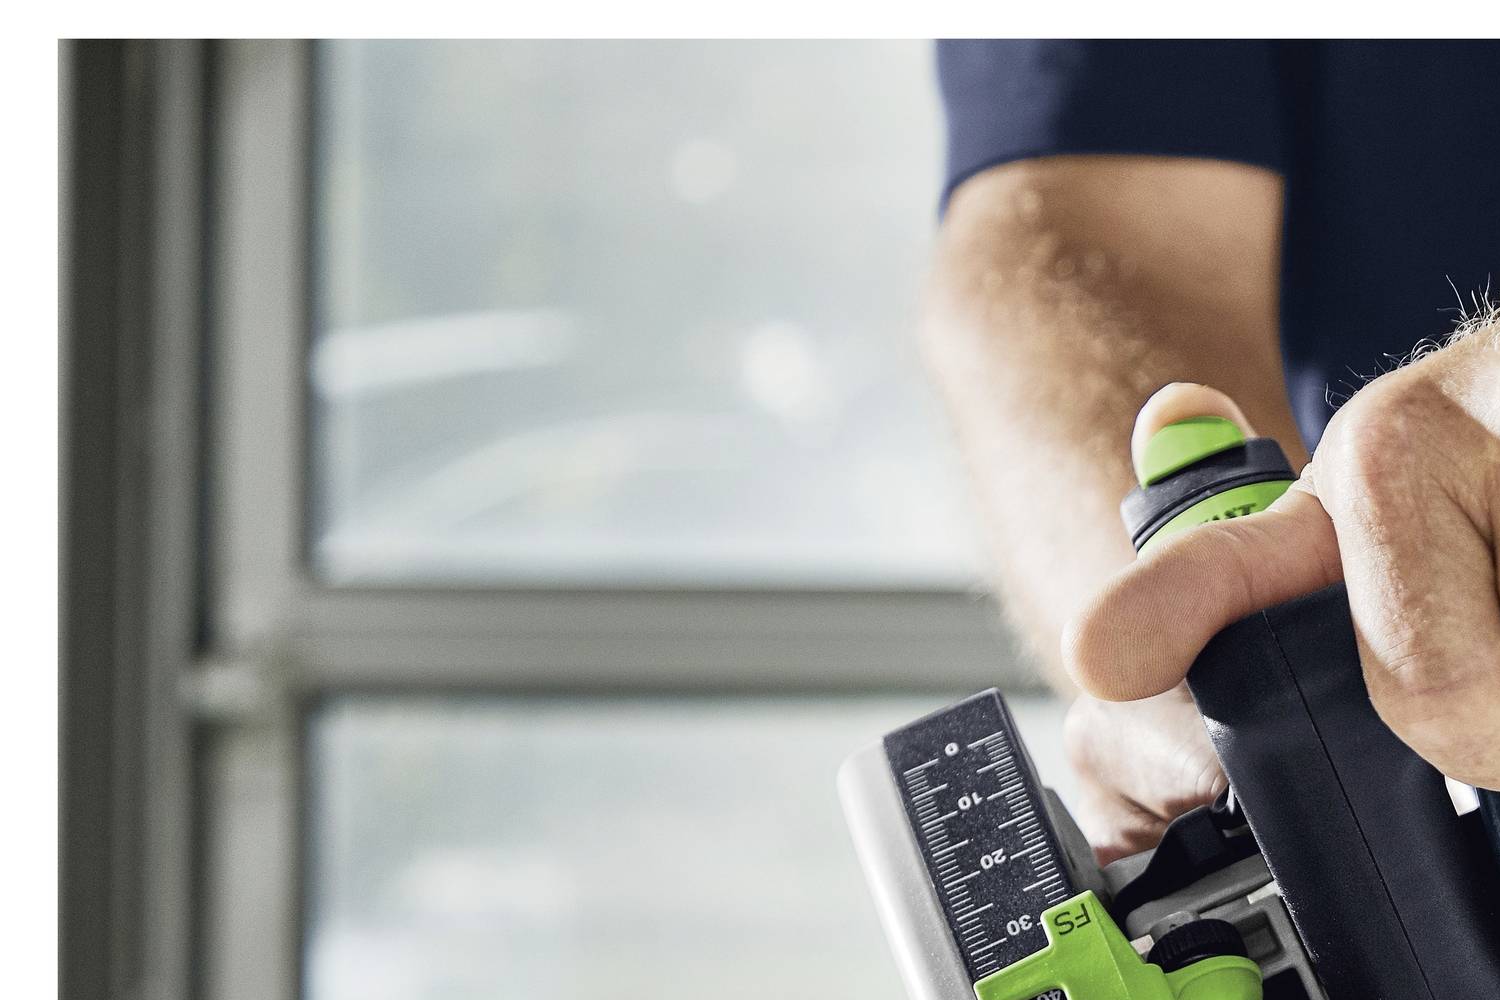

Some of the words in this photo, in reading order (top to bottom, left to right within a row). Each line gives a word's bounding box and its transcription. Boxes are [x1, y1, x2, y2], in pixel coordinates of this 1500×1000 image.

[944, 742, 960, 757] 0
[957, 793, 983, 811] 10
[979, 848, 1007, 870] 20
[1006, 914, 1033, 936] 30
[1054, 903, 1091, 935] FS
